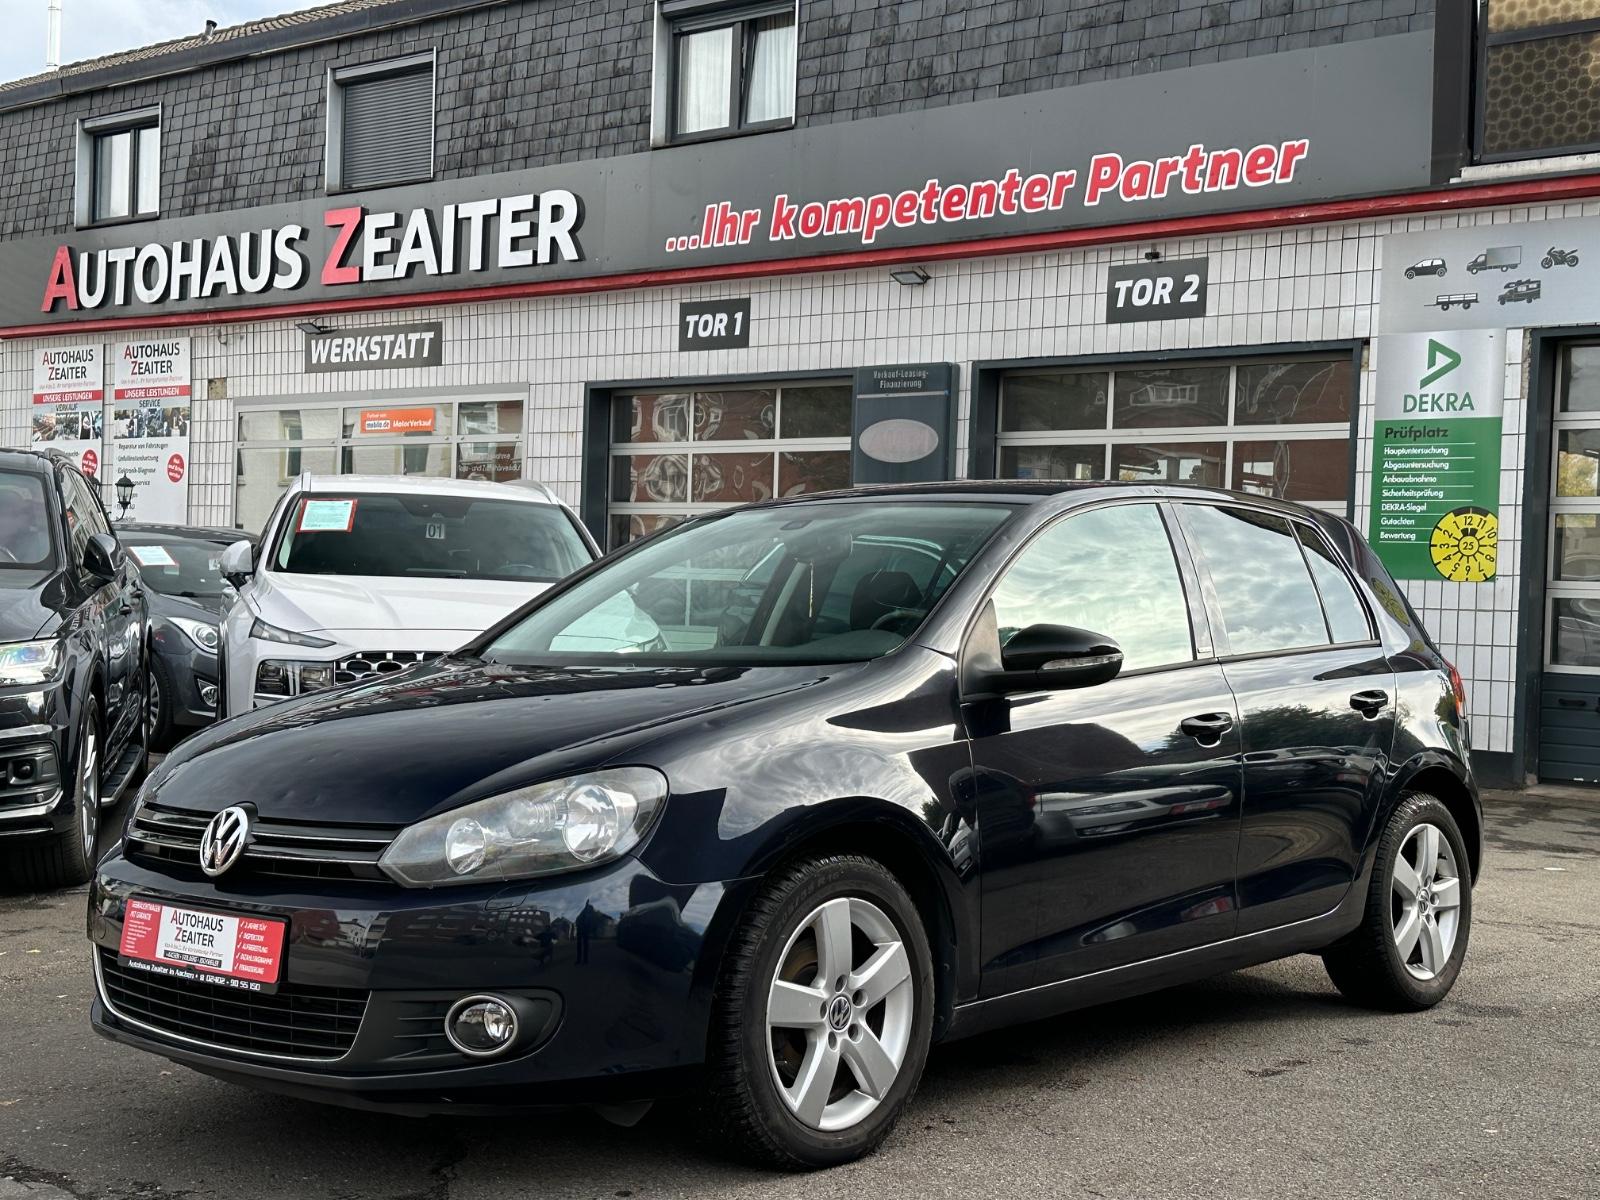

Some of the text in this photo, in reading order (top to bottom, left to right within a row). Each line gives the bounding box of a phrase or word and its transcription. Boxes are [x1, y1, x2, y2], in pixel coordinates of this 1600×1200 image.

[664, 138, 1309, 252] ...Ihr kompetenter Partner
[40, 189, 581, 314] AUTOHAUS ZEAITER
[1114, 274, 1200, 308] TOR 2
[686, 311, 743, 339] TOR 1
[124, 342, 180, 359] AUTOHAUS
[310, 331, 434, 364] WERKSTATT
[42, 349, 94, 365] AUTOHAUS
[131, 360, 173, 375] ZEAITER
[48, 366, 87, 381] ZEAITER
[880, 380, 922, 389] Finanzierung
[124, 387, 180, 398] UNSERE LEISTUNGEN
[139, 399, 160, 408] SERVICE
[1403, 391, 1475, 413] DEKRA
[1385, 425, 1449, 441] Prüfplatz
[1384, 446, 1449, 456] Hauptuntersuchung
[1383, 460, 1450, 470] Abgasuntersuchung
[1382, 475, 1437, 483] Anbauabnahme
[1382, 488, 1444, 498] Sicherheitsprüfung
[1381, 503, 1427, 512] DEKRA-Siegel
[1380, 517, 1415, 525] Gutachten
[1453, 520, 1460, 529] 1
[1464, 516, 1473, 525] 12
[1477, 518, 1487, 529] 11
[1380, 531, 1416, 541] Bewertung
[1443, 529, 1453, 538] 2
[1485, 526, 1497, 539] 10
[1463, 541, 1474, 550] 25
[1485, 554, 1495, 562] 8
[1451, 562, 1460, 572] 5
[171, 910, 224, 932] AUTOHAUS
[175, 927, 214, 948] ZEAITER
[128, 960, 151, 970] Autohaus
[151, 964, 169, 974] Zeaiter
[175, 969, 194, 979] Aachen
